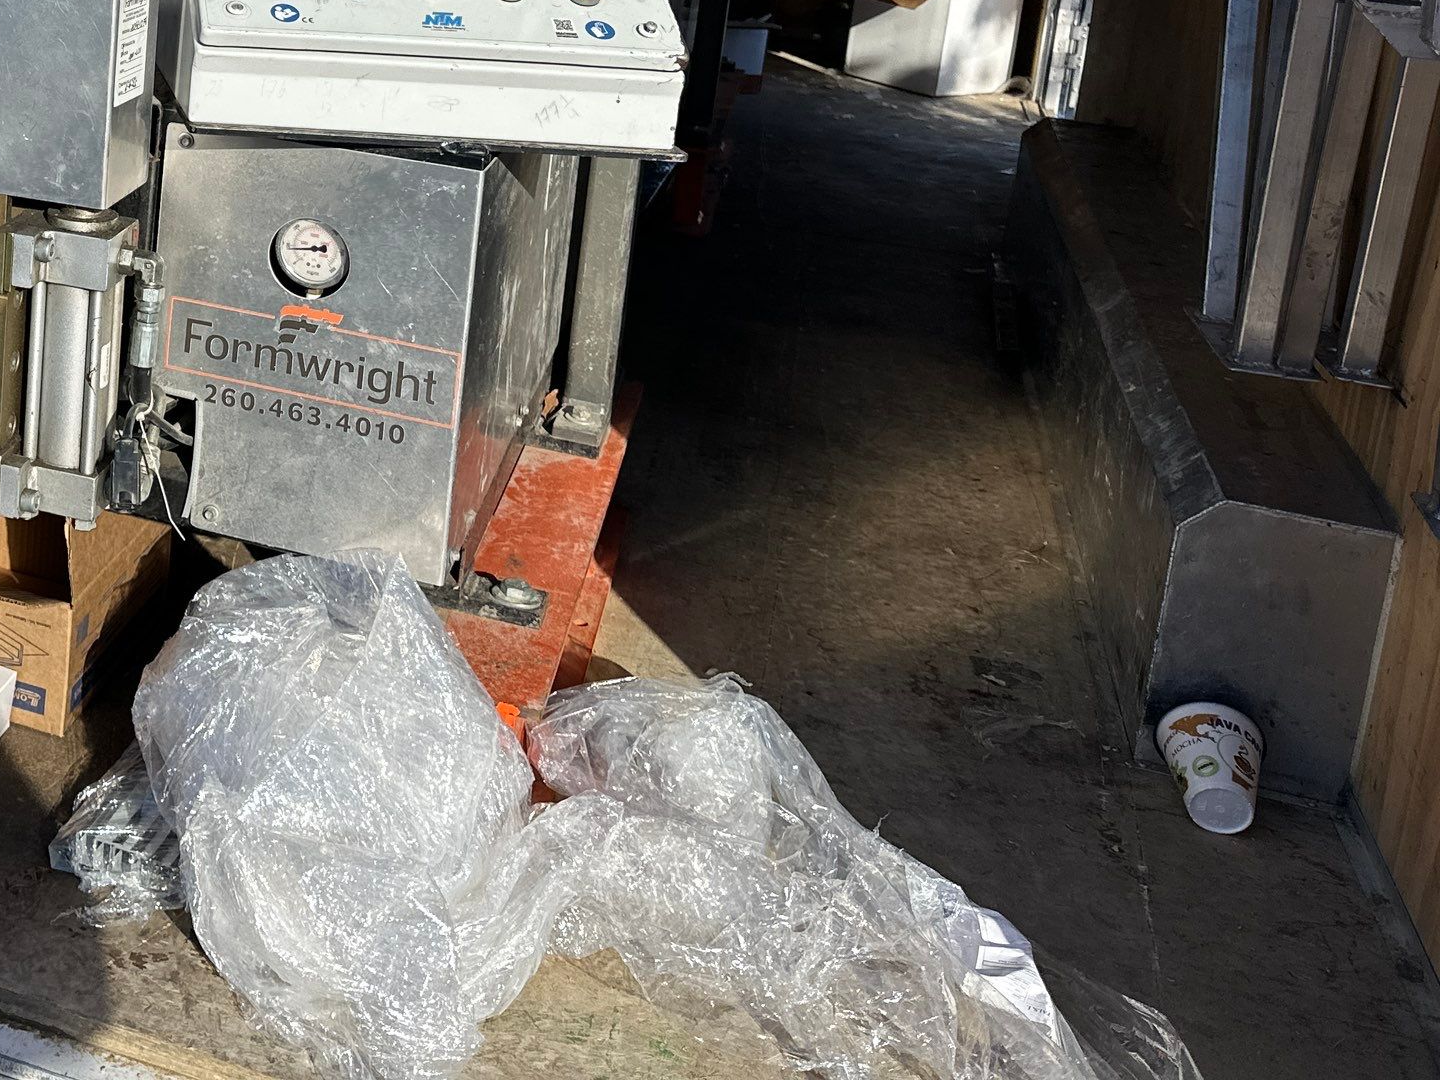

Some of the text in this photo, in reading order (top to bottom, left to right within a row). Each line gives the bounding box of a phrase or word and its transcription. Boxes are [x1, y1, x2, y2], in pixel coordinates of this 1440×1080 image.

[422, 11, 464, 27] NTM
[183, 318, 437, 405] Formwright
[203, 384, 405, 445] 260.463.4010
[1207, 717, 1242, 735] JAVA
[1171, 738, 1203, 758] MOCHA
